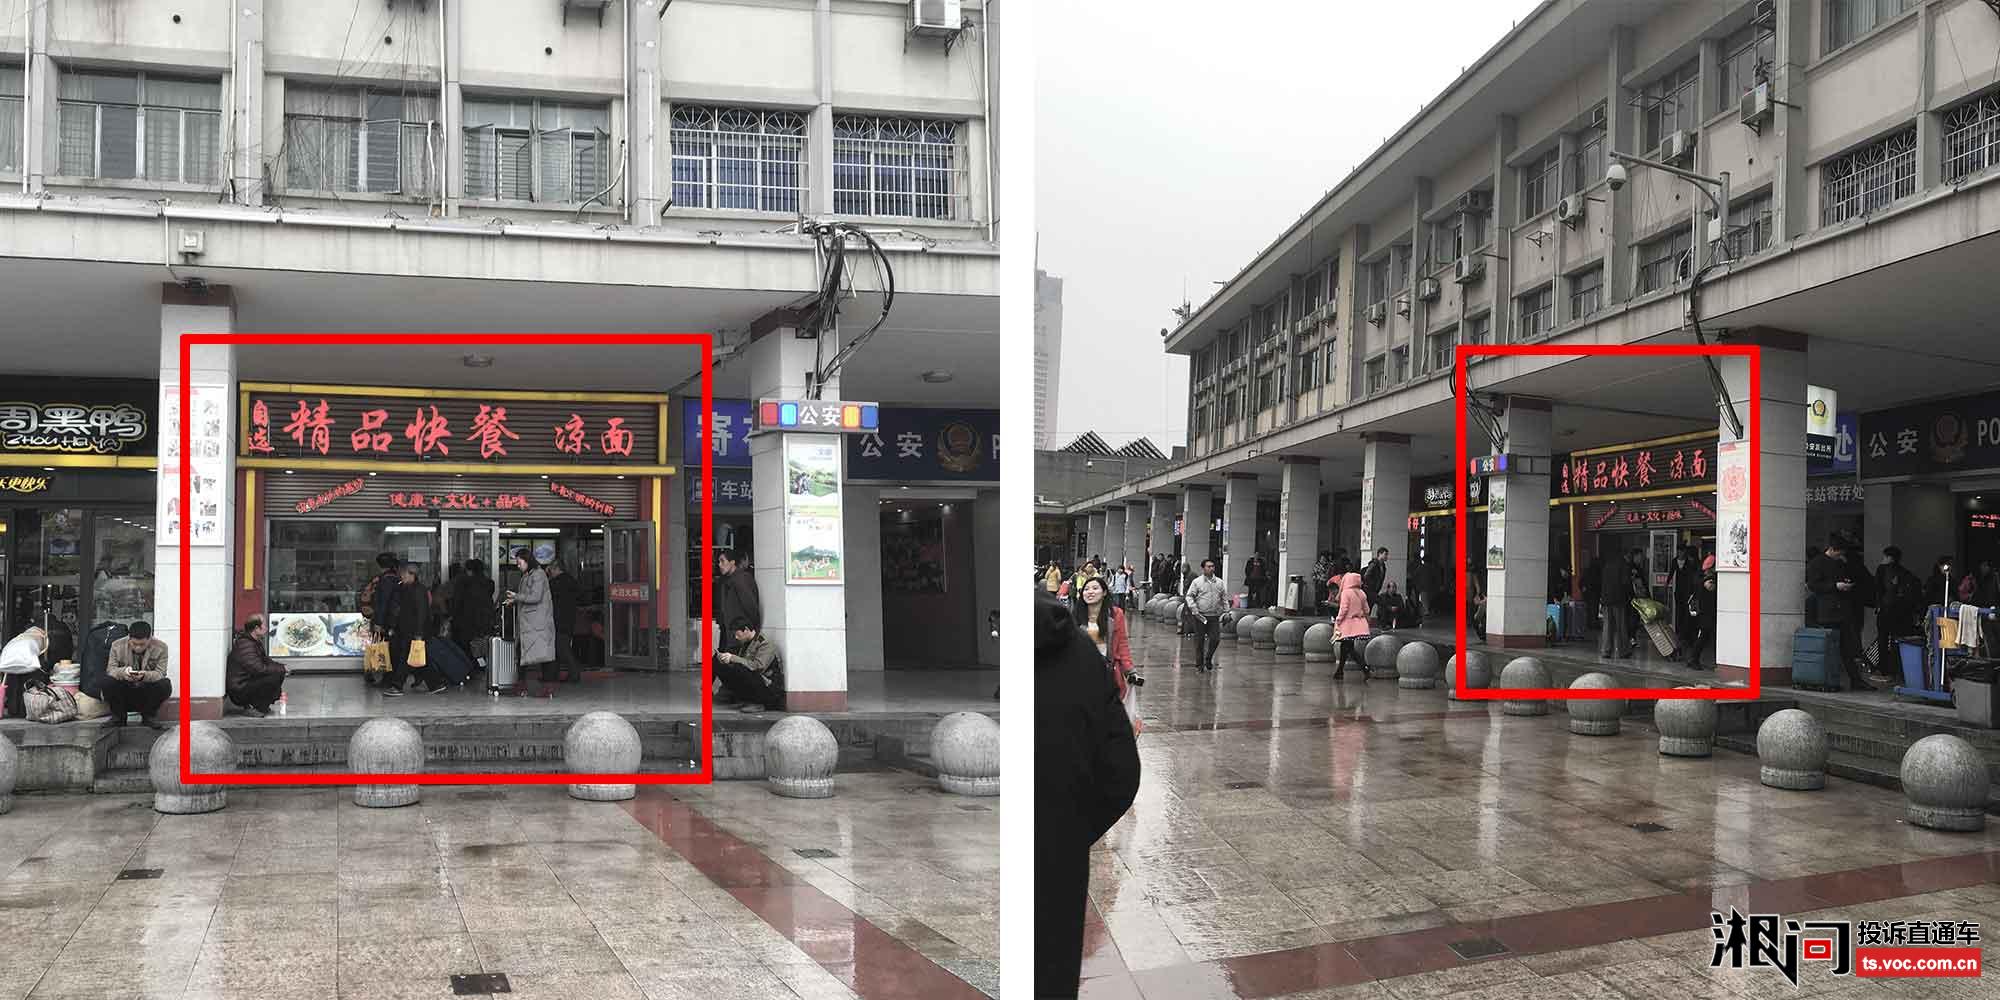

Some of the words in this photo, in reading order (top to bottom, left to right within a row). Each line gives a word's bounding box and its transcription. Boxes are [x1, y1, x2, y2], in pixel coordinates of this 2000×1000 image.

[0, 405, 147, 436] 周黑鸭
[283, 400, 519, 458] 精品快餐
[553, 413, 634, 456] 凉面
[800, 404, 841, 426] 公安
[860, 431, 923, 458] 公安
[1868, 428, 1920, 458] 公安
[1573, 451, 1656, 492] 精品快餐
[1670, 449, 1707, 479] 凉面
